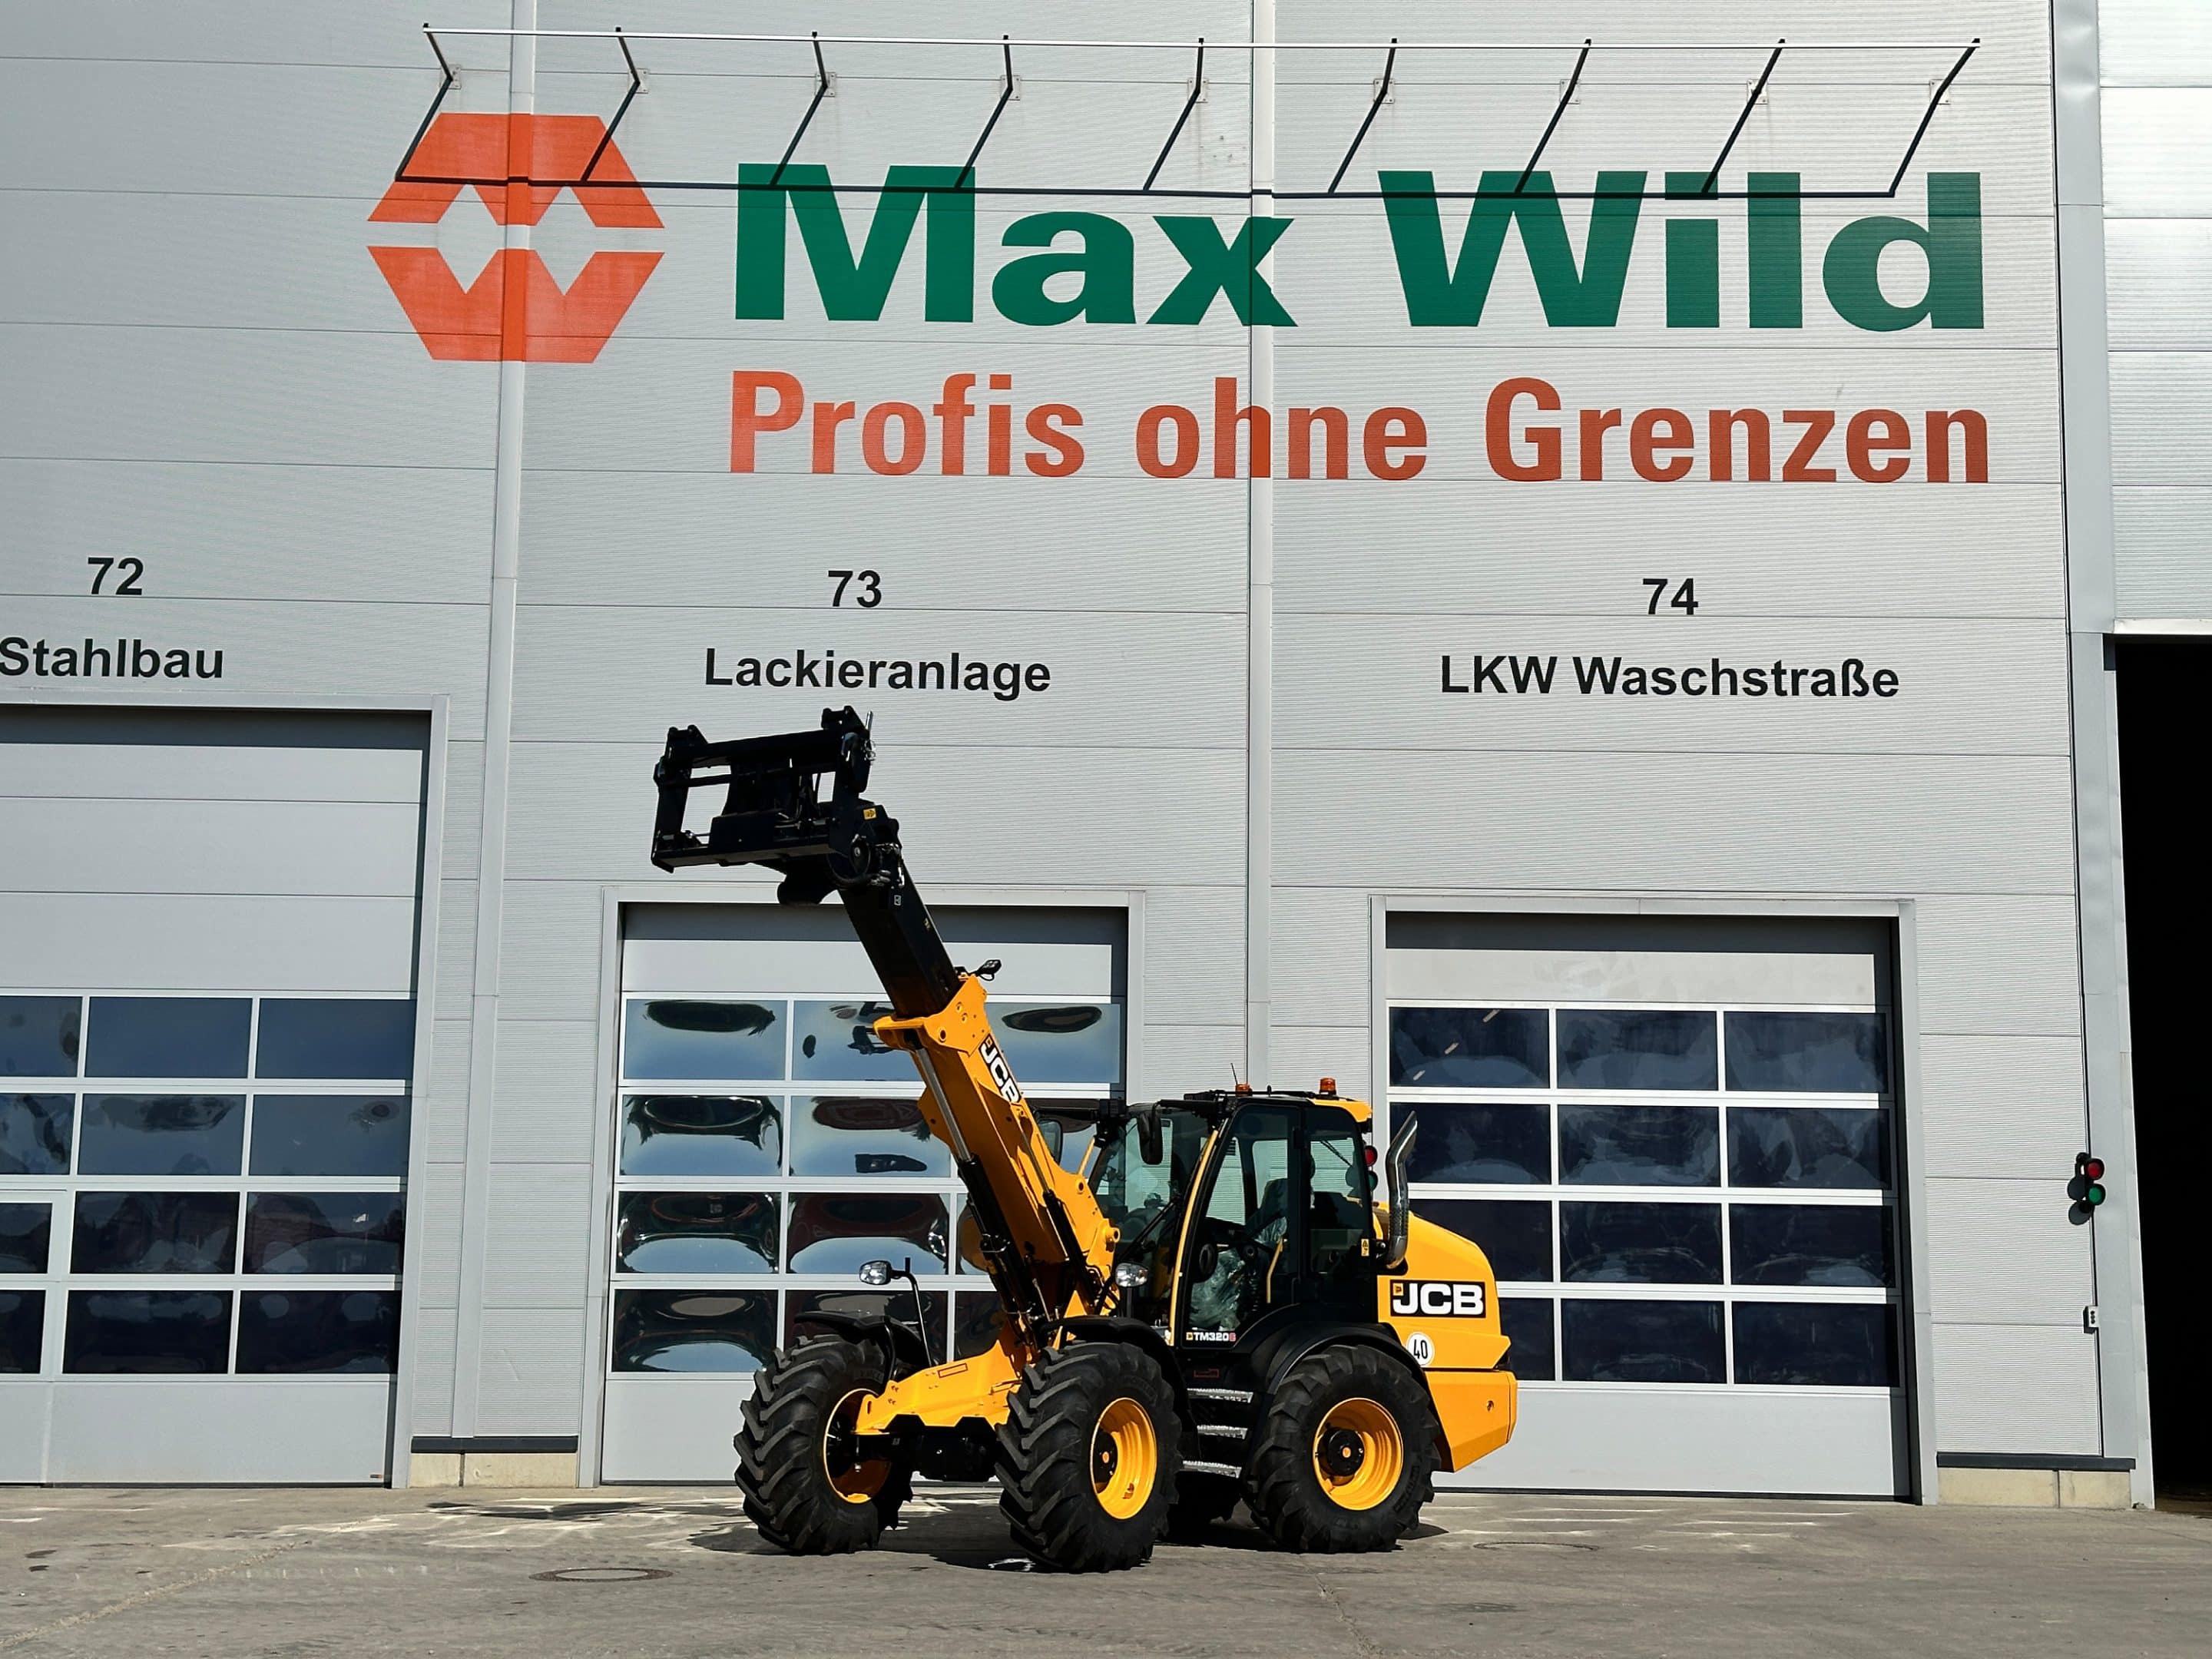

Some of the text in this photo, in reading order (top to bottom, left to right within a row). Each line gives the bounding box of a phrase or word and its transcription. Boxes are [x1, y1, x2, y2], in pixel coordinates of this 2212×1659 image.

[735, 163, 1983, 331] Max Wild
[730, 370, 1988, 483] Profis ohne Grenzen
[88, 557, 144, 595] 72
[828, 570, 882, 608] 73
[1642, 578, 1699, 616] 74
[0, 637, 224, 679] Stahlbau
[705, 647, 1051, 701] Lackieranlage
[1442, 655, 1899, 697] LKW Waschstraße
[980, 1042, 1020, 1103] JCB
[1392, 1283, 1484, 1315] JCB
[1413, 1339, 1429, 1359] 40
